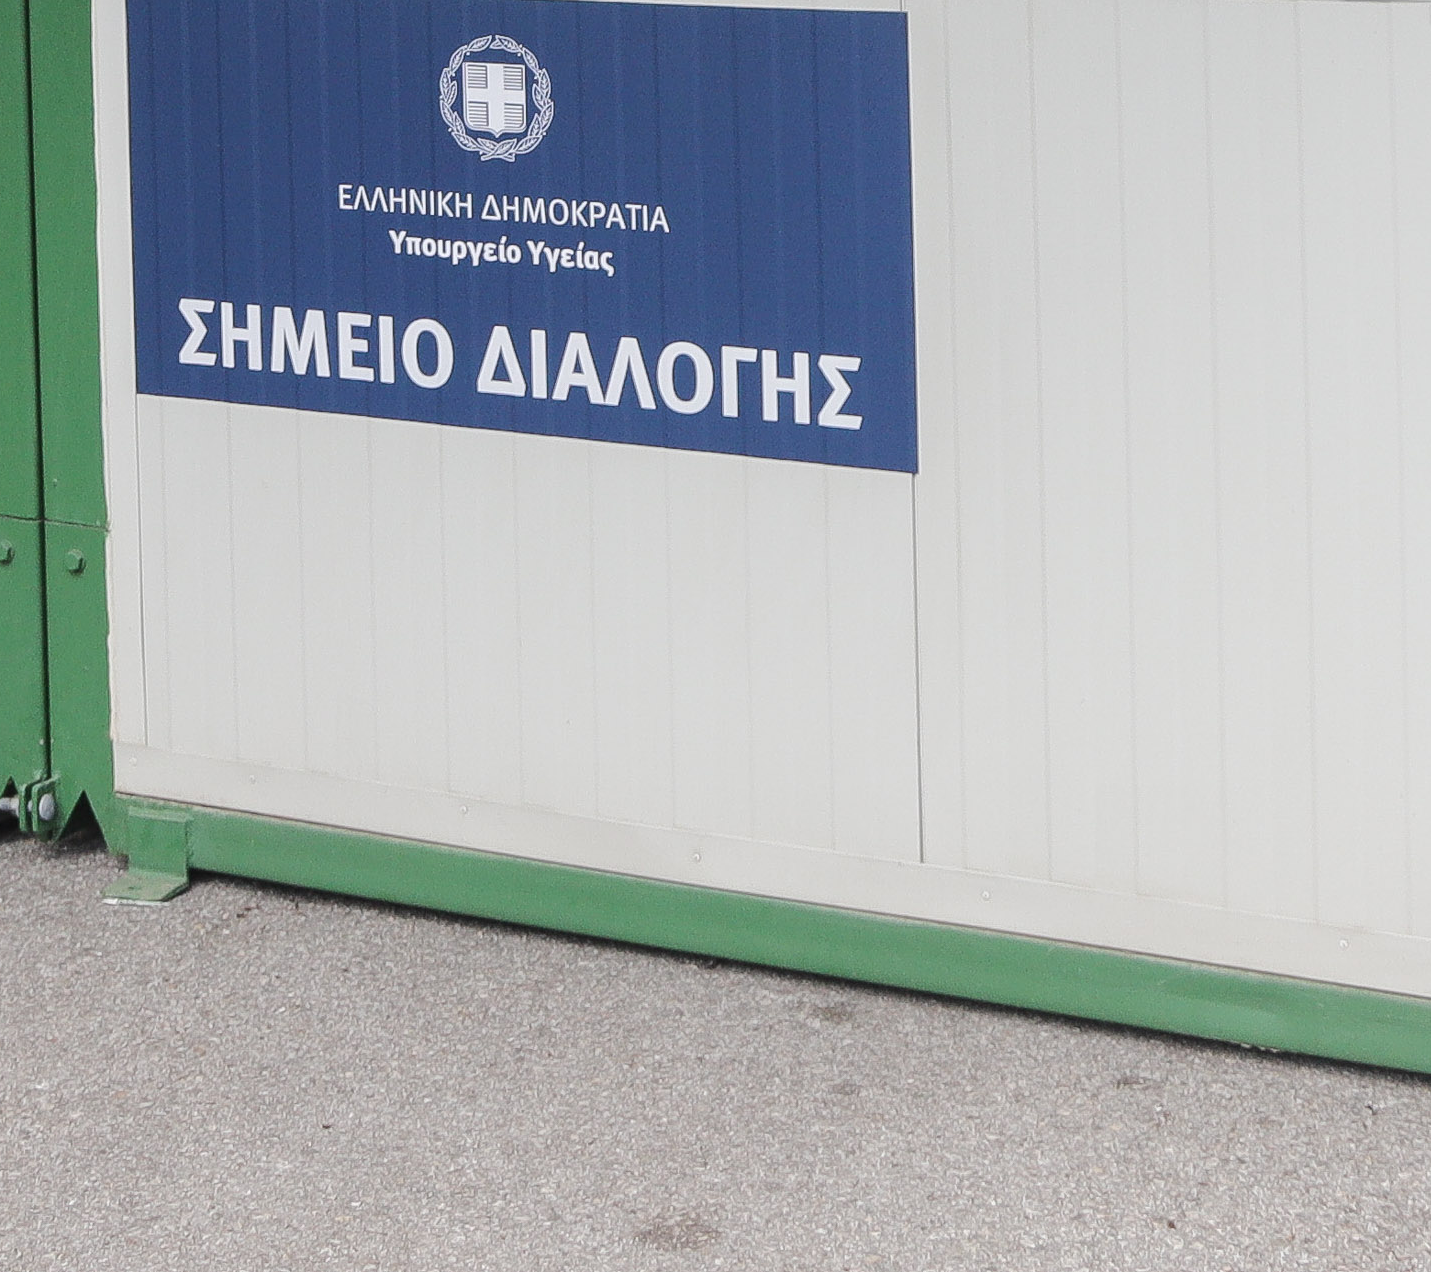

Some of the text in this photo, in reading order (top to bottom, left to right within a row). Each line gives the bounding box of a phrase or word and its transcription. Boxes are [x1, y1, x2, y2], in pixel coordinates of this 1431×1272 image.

[338, 184, 670, 233] ΕΛΛΗΝΙΚΗ ΔΗΜΟΚΡΑΤΙΑ
[388, 229, 615, 277] Υπουργείο Υγείας
[178, 298, 864, 430] ΣΗΜΕΙΟ ΔΙΑΛΟΓΗΣ
